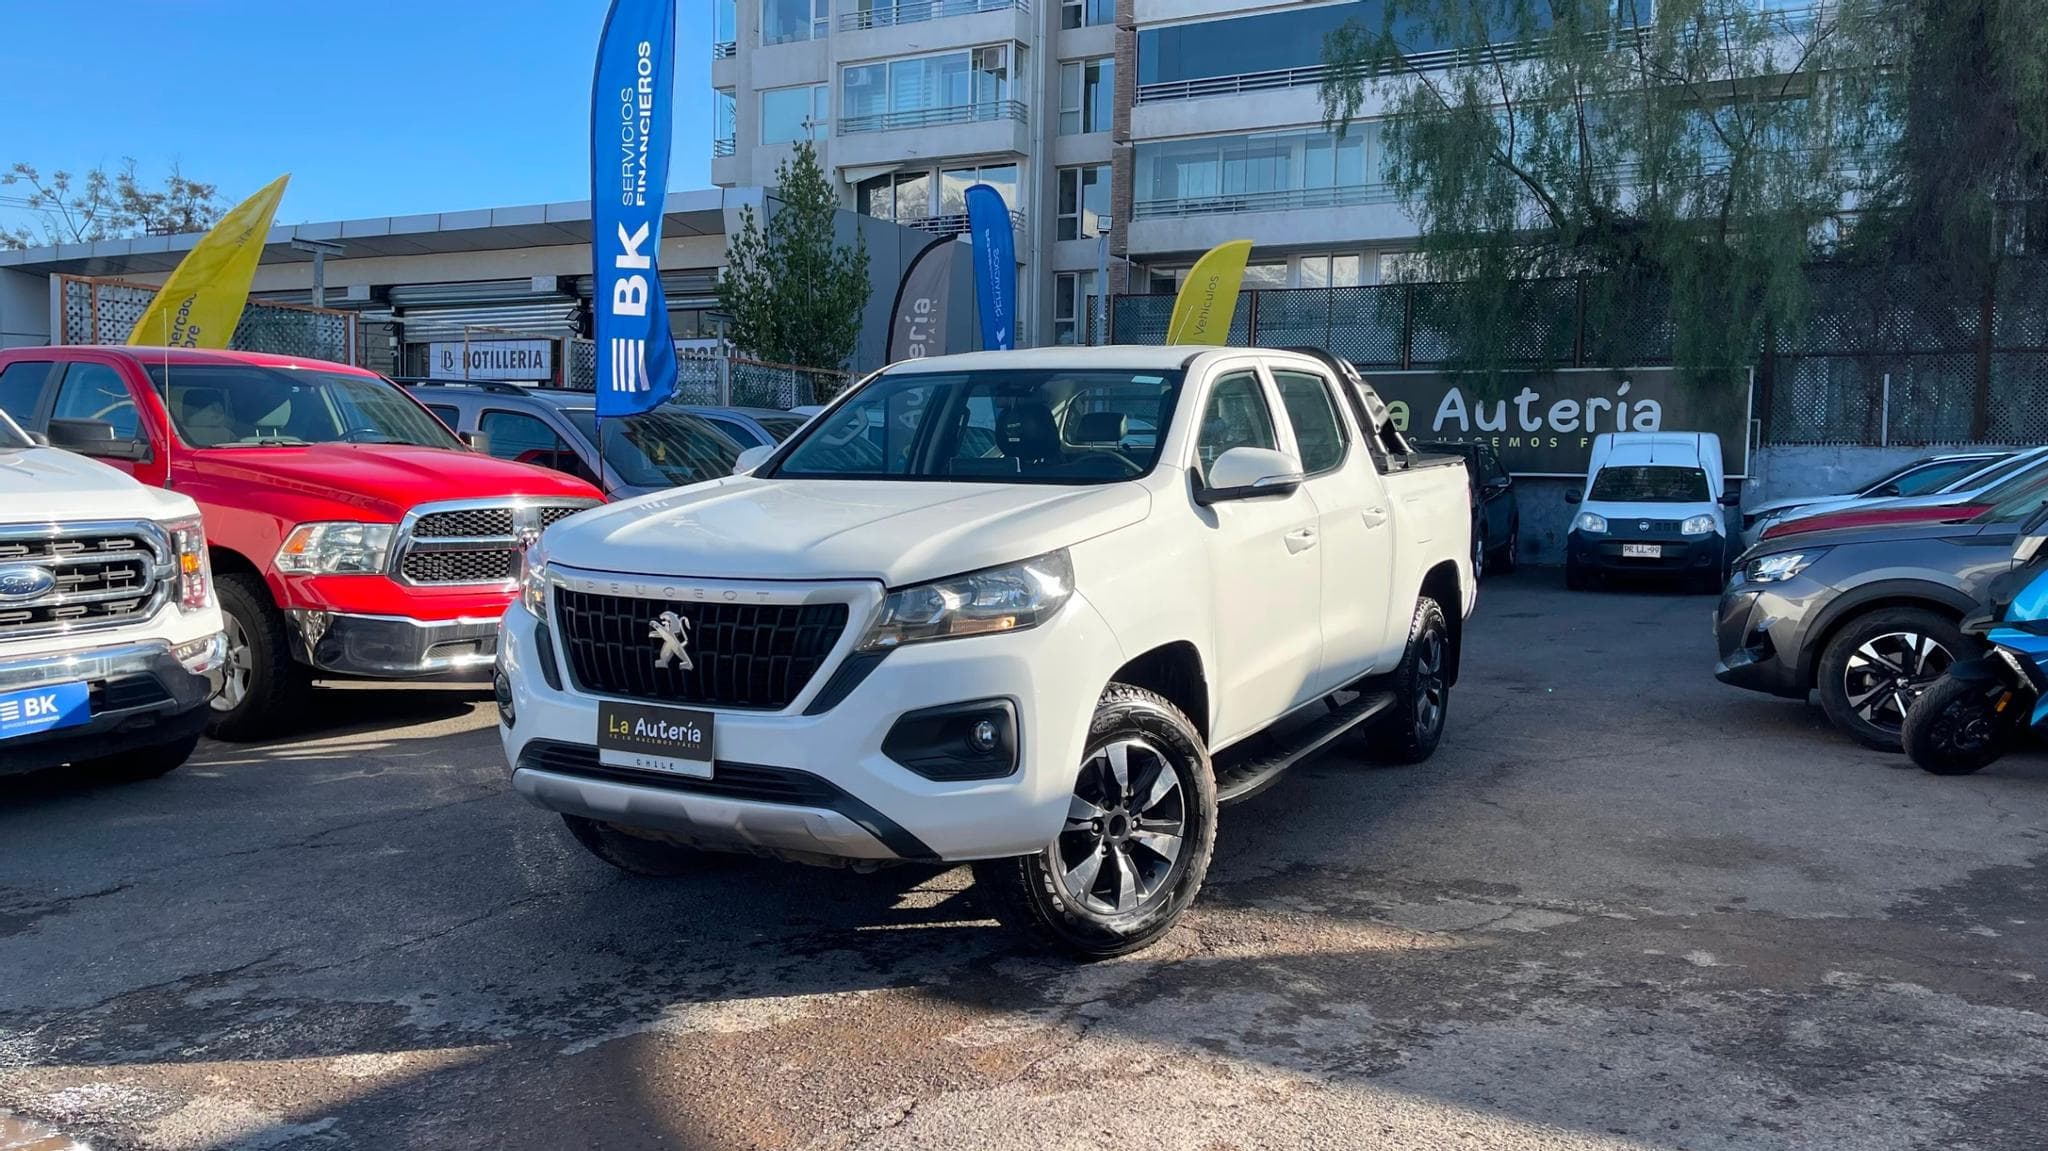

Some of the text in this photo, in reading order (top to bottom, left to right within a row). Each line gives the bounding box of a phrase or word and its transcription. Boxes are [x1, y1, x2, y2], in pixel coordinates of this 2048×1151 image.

[636, 41, 652, 207] FINANCIEROS
[621, 87, 635, 206] SERVICIOS
[613, 221, 651, 317] BK
[463, 350, 543, 369] BOTILLERIA
[1432, 381, 1662, 433] Autería
[587, 580, 770, 602] PEUGEOT
[24, 694, 59, 717] BK
[609, 714, 702, 743] La Autería
[636, 759, 675, 771] CHILE
